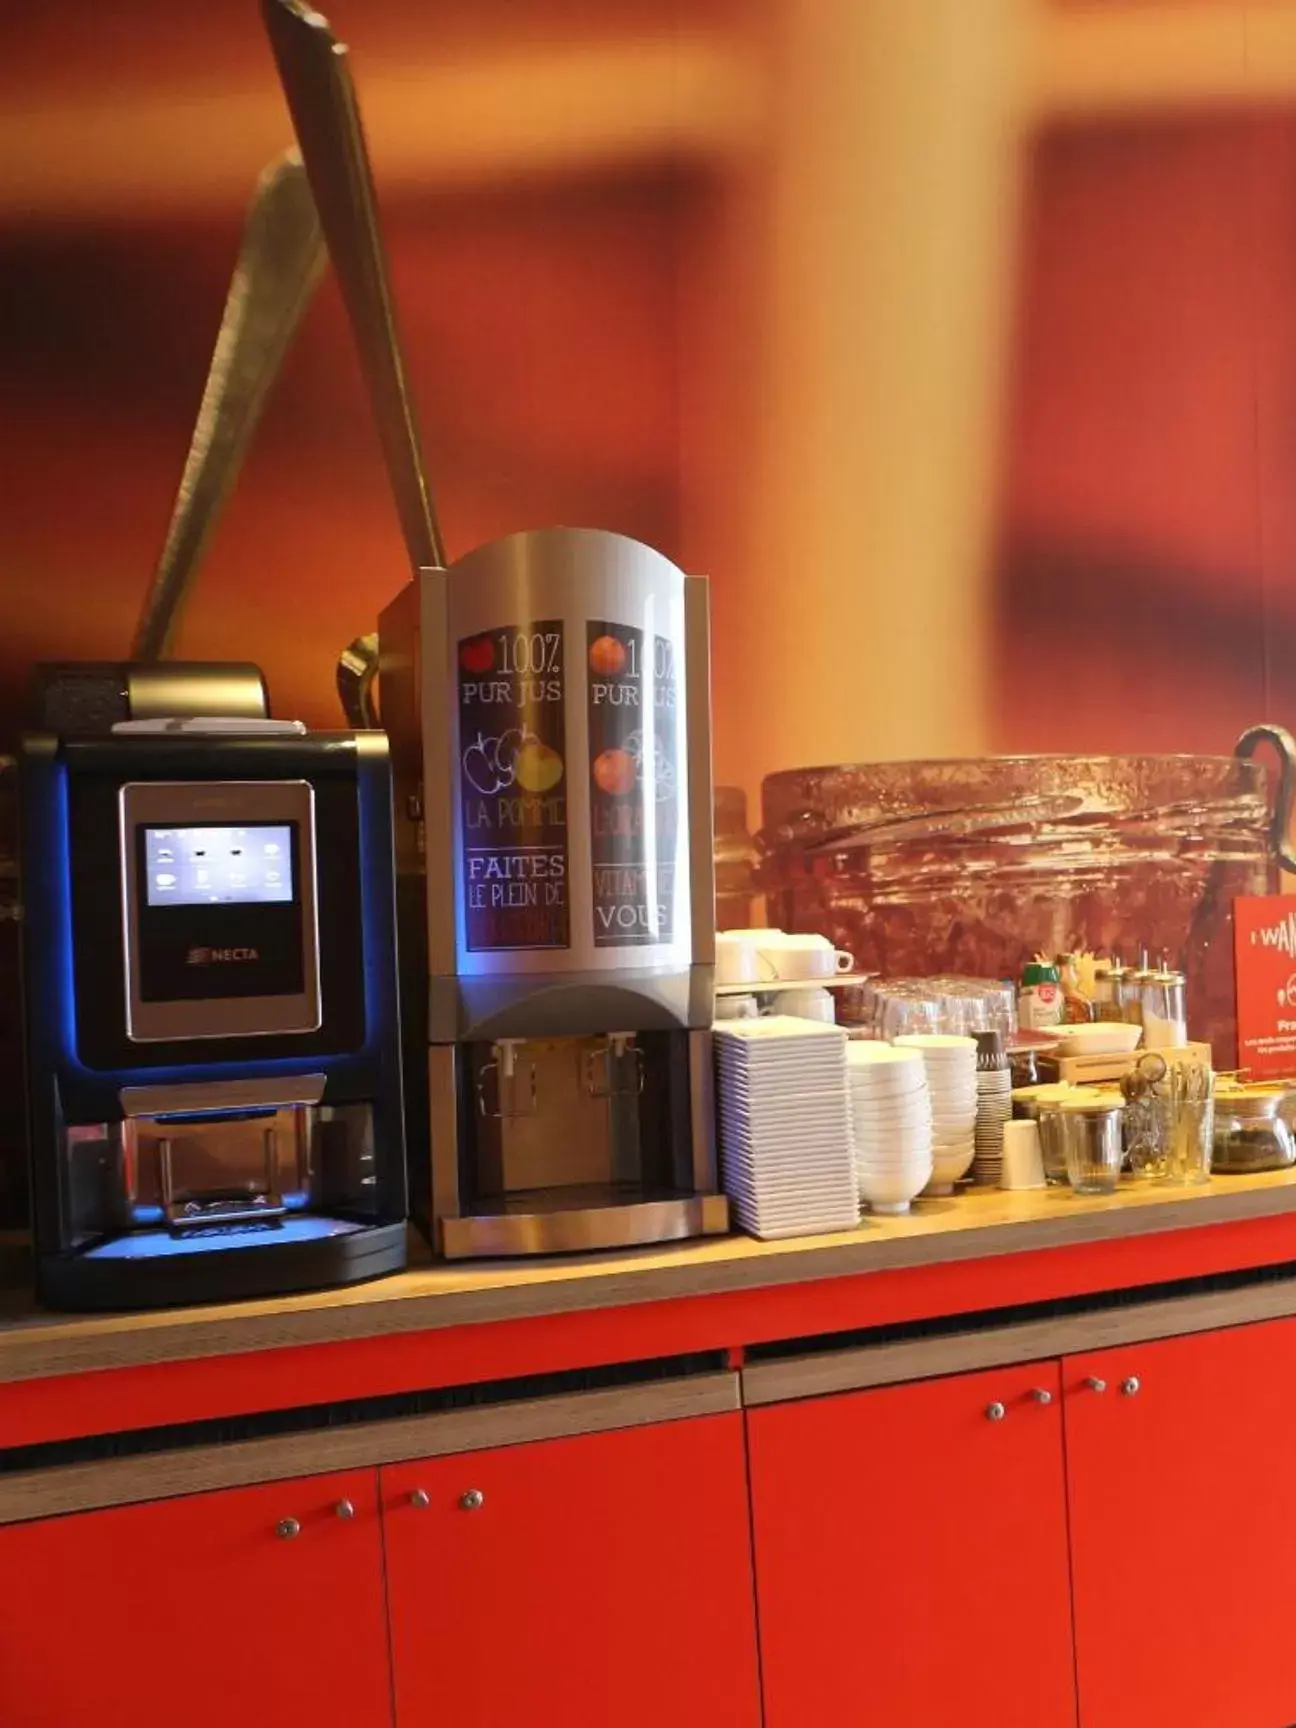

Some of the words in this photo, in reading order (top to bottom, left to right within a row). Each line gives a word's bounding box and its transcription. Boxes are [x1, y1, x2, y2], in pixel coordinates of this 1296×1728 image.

[497, 633, 560, 674] 100%
[462, 681, 512, 704] PUR
[517, 681, 561, 708] JUS
[592, 683, 640, 706] PUR
[465, 801, 491, 829] LA
[499, 797, 566, 829] POMME
[468, 854, 565, 880] FAITES
[469, 884, 486, 908] LE
[491, 882, 537, 908] PLEIN
[545, 881, 565, 906] DE
[595, 904, 668, 929] VOUS
[1250, 930, 1256, 946] I
[211, 949, 258, 961] NECTA
